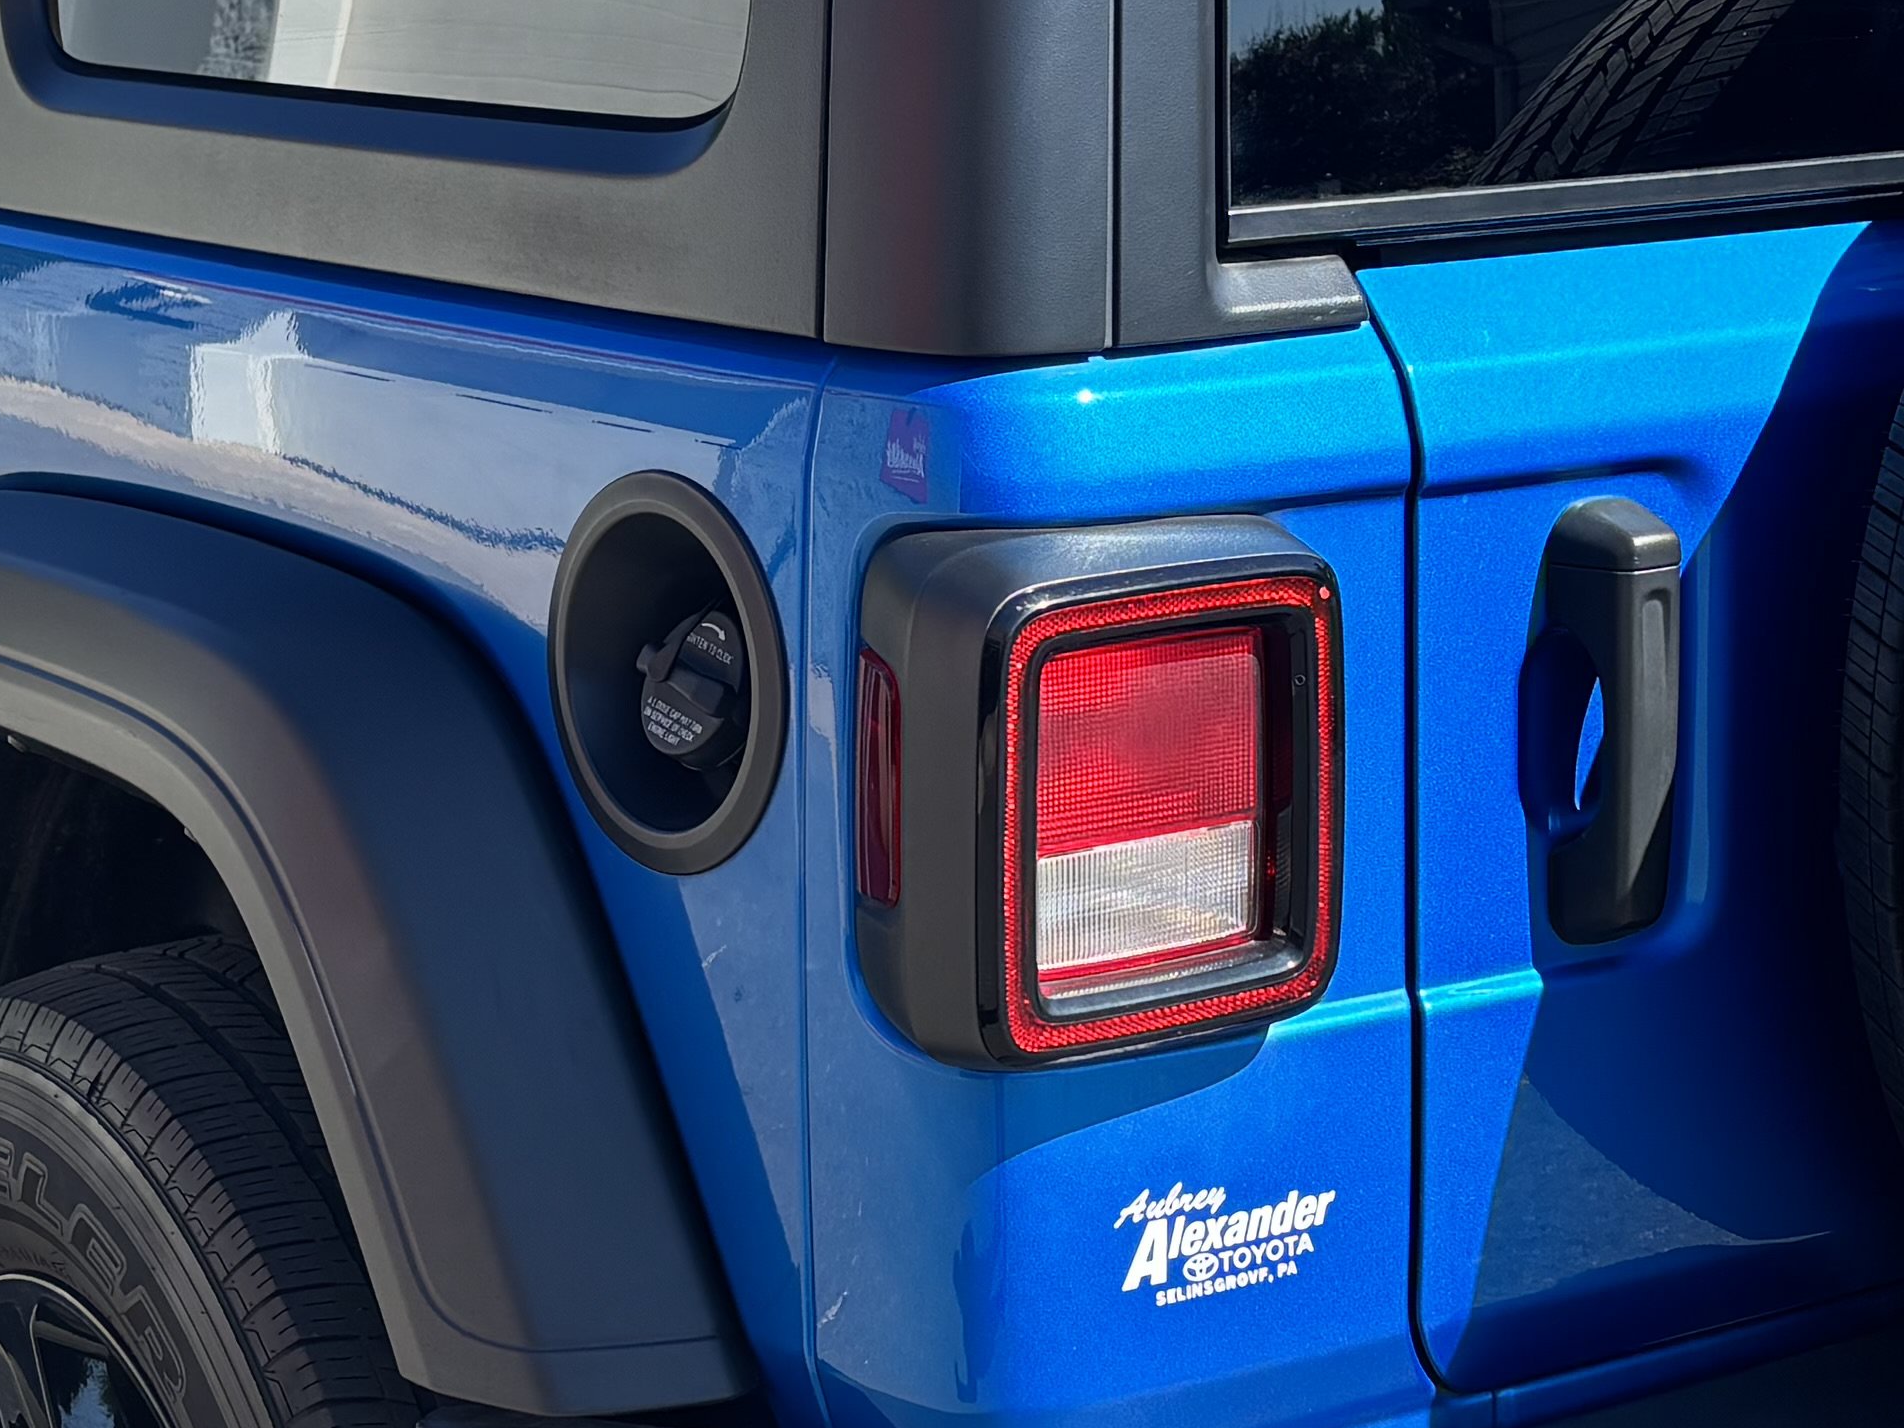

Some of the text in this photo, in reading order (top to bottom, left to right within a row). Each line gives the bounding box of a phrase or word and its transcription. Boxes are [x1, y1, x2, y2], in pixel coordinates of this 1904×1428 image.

[1113, 1181, 1227, 1229] Aubrey
[1121, 1189, 1336, 1293] Alexander
[1219, 1232, 1315, 1273] TOYOTA
[1277, 1260, 1298, 1278] PA
